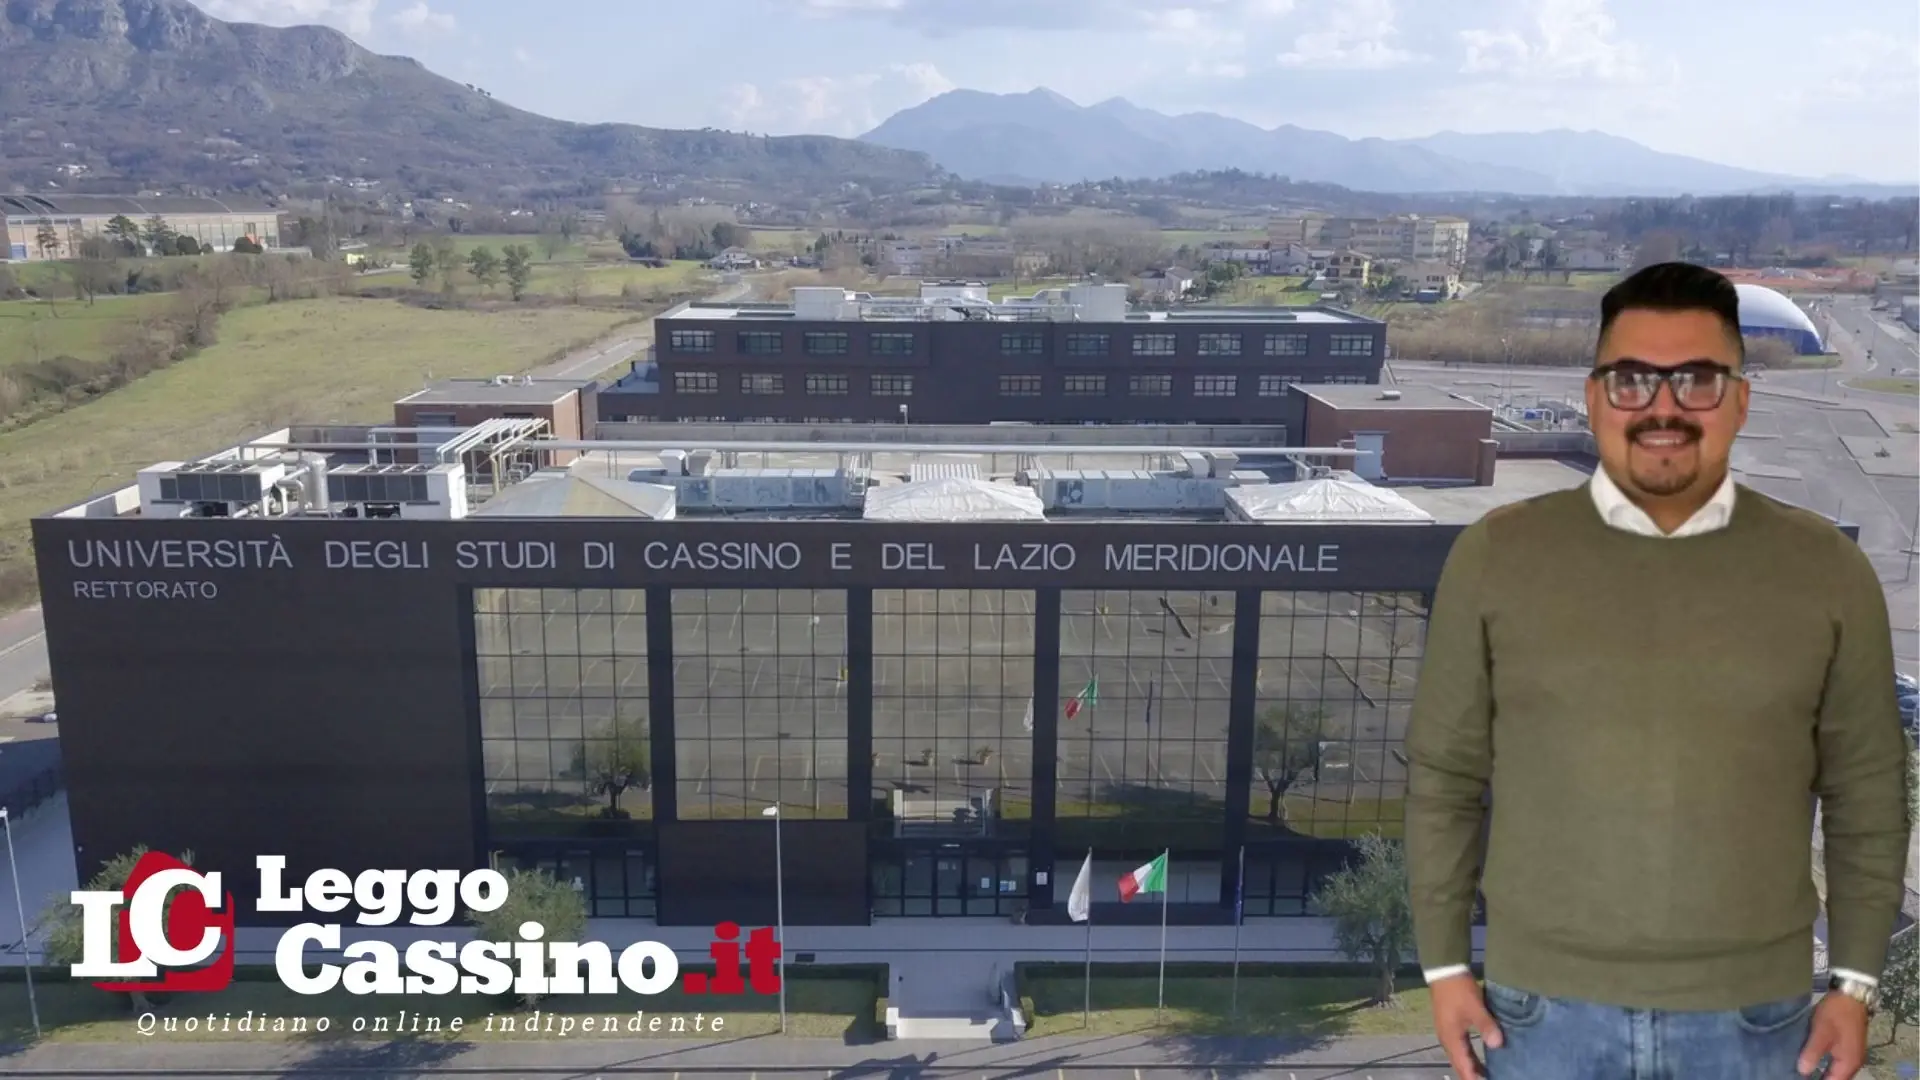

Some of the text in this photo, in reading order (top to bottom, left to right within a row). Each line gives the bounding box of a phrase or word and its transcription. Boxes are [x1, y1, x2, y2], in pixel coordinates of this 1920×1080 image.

[68, 533, 1340, 572] UNIVERSITÀ DEGLI STUDI DI CASSINO E DEL LAZIO MERIDIONALE
[73, 581, 218, 599] RETTORATO
